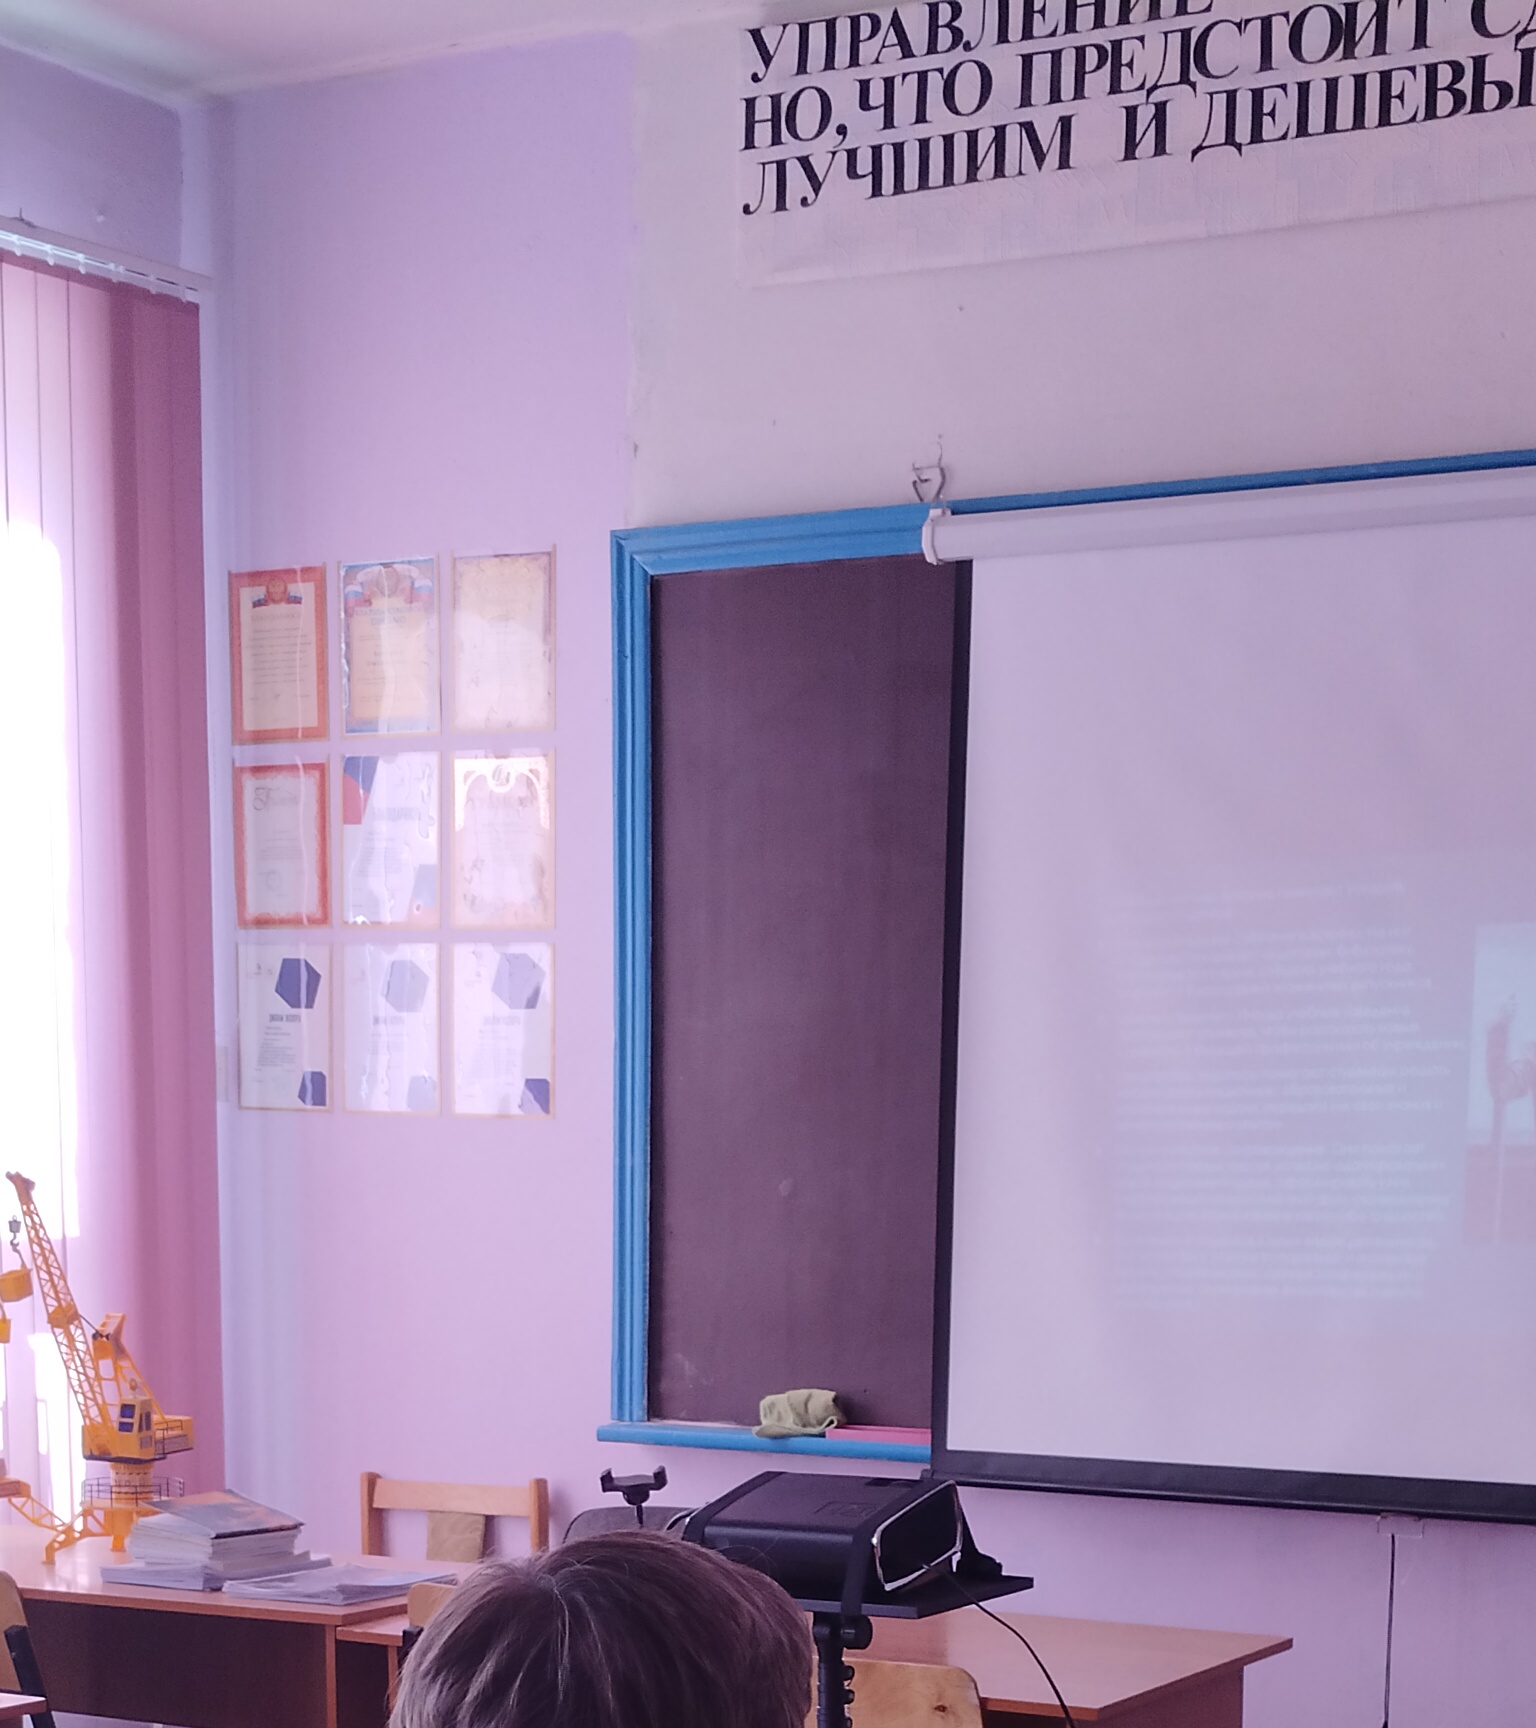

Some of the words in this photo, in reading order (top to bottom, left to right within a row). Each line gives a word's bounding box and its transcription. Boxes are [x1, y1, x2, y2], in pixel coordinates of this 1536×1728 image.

[746, 0, 1214, 84] УПРАВЛЕН
[1014, 0, 1432, 110] ПРЕДСТОИТ
[741, 112, 1075, 217] ЛУЧШИМ
[1119, 98, 1172, 163] И
